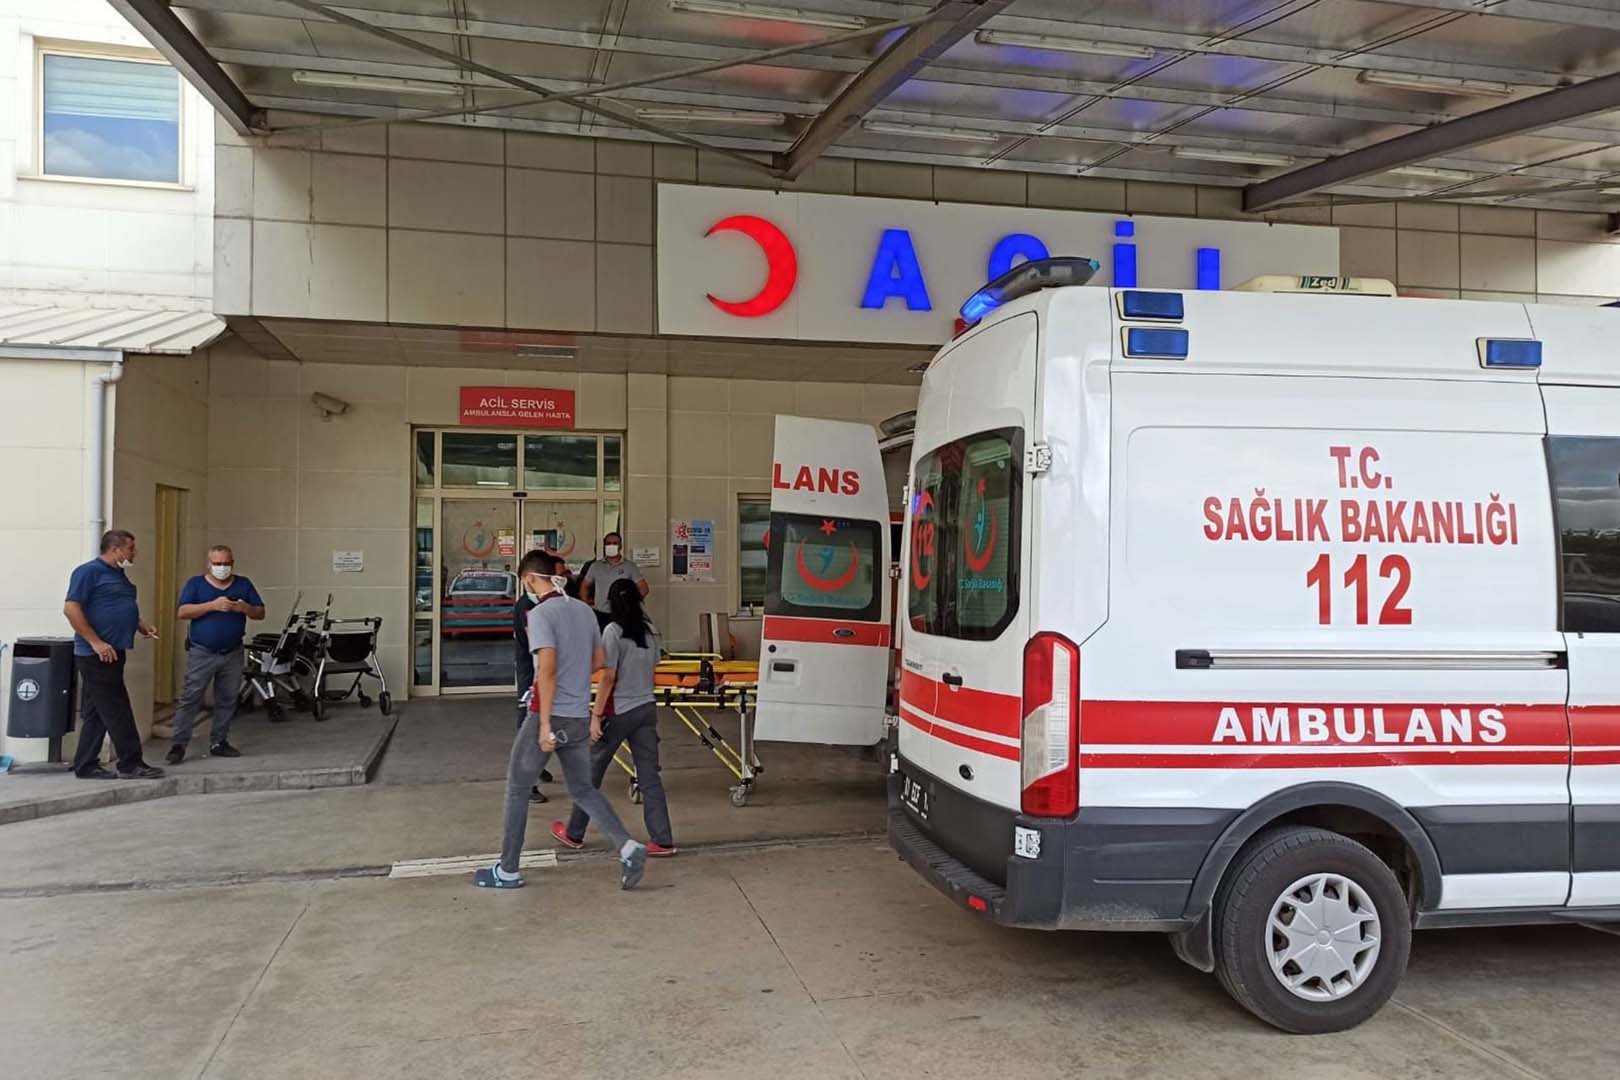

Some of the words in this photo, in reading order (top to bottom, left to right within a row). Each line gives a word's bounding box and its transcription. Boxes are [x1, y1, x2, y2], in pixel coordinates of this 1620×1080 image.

[1311, 276, 1337, 287] Zed
[463, 409, 518, 417] AMBULANSLA
[518, 410, 545, 418] GELEN
[545, 411, 571, 419] HASTA
[480, 395, 508, 408] ACİL
[511, 398, 556, 410] SERVİS
[773, 463, 860, 496] LANS
[1330, 447, 1392, 488] T.C.
[1203, 488, 1330, 542] SAĞLIK
[1341, 493, 1519, 545] BAKANLIĞI
[1306, 553, 1413, 625] 112
[1212, 705, 1507, 744] AMBULANS
